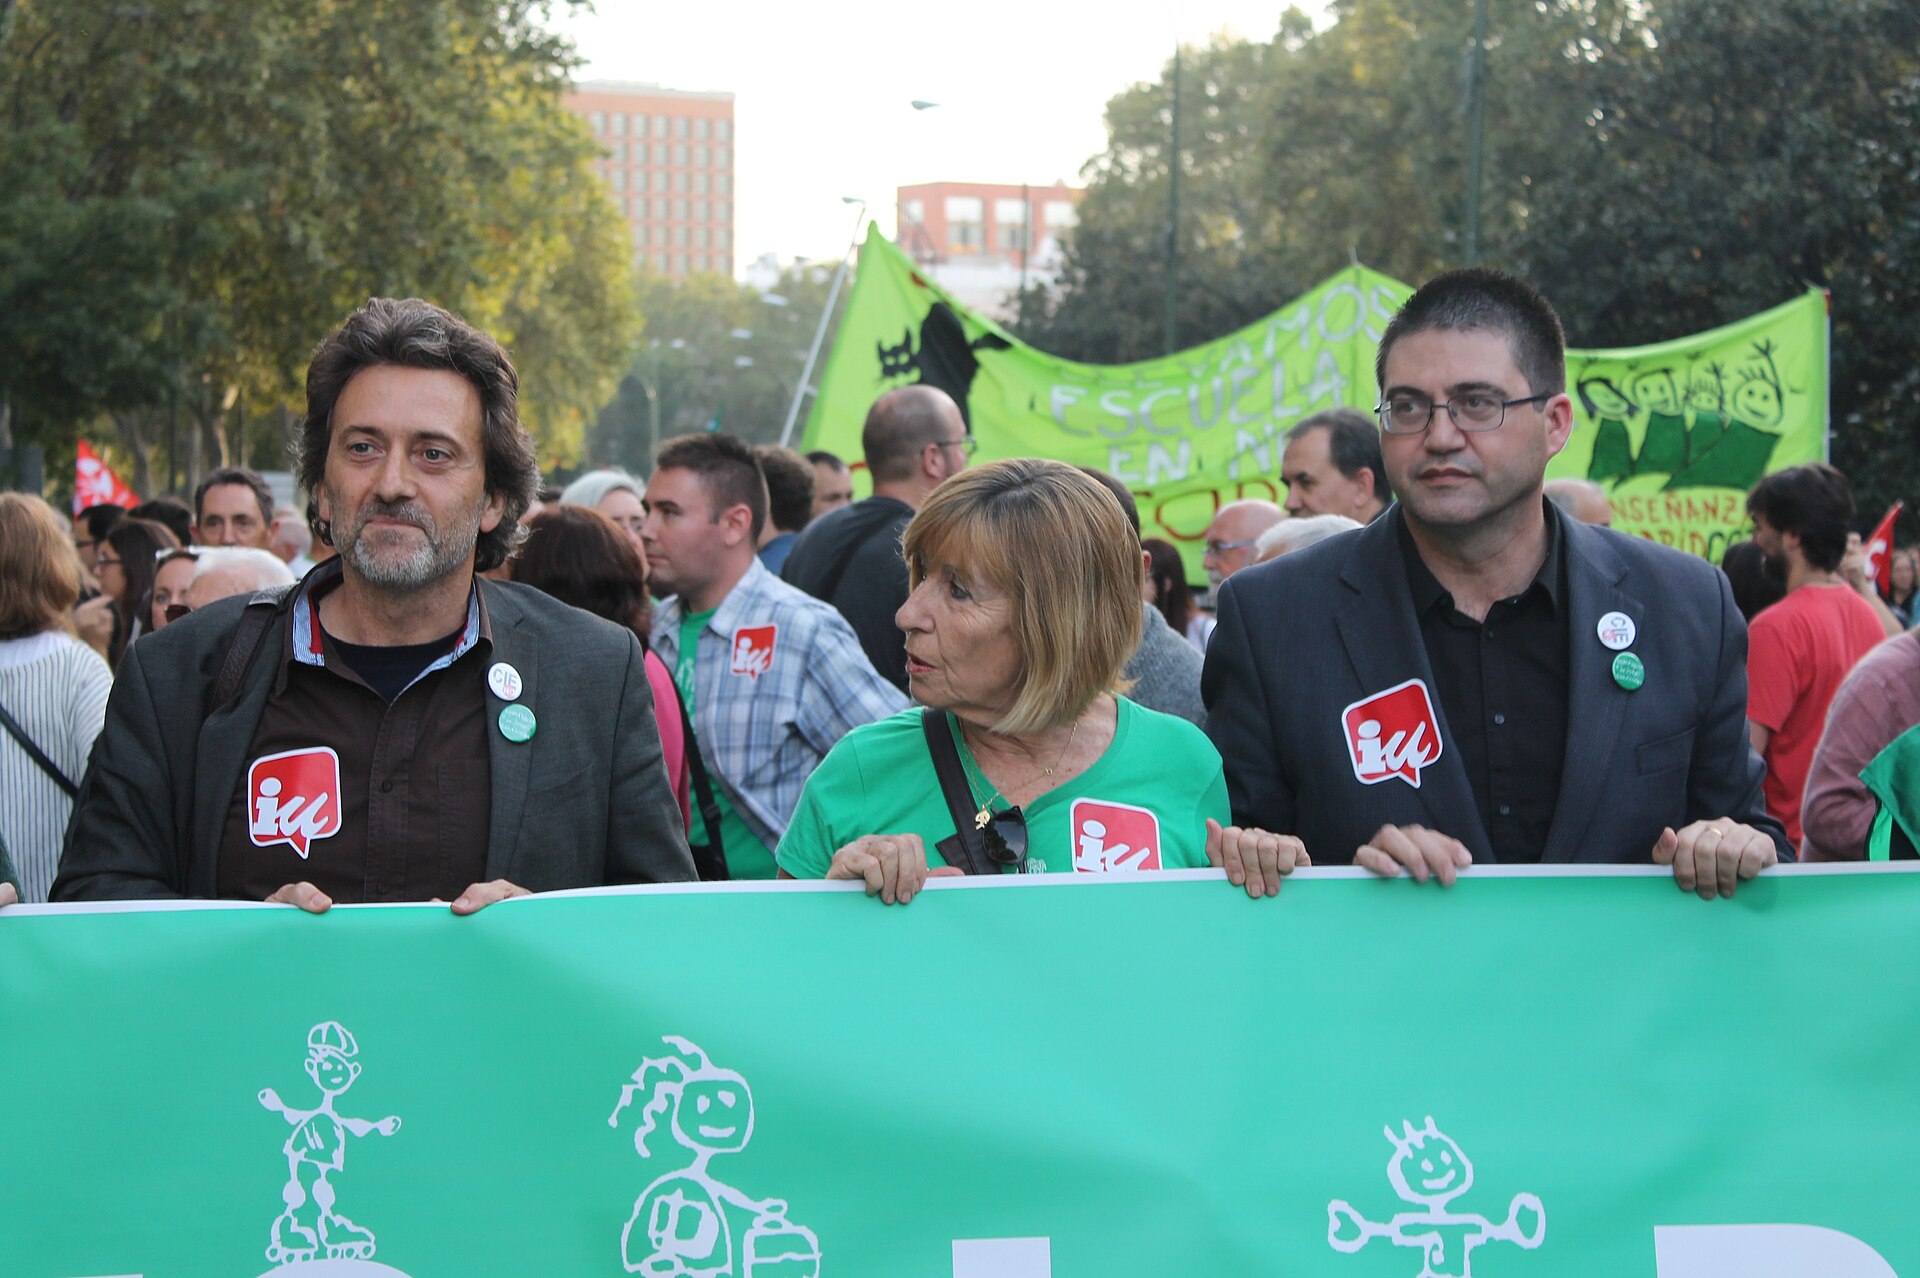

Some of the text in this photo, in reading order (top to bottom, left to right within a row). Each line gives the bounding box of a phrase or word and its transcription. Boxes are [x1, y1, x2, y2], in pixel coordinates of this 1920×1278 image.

[1050, 350, 1347, 438] ESCUELA
[1107, 438, 1192, 485] EN
[735, 637, 771, 671] iu
[493, 668, 518, 691] CIE
[1357, 719, 1432, 773] iu
[253, 777, 329, 837] iu
